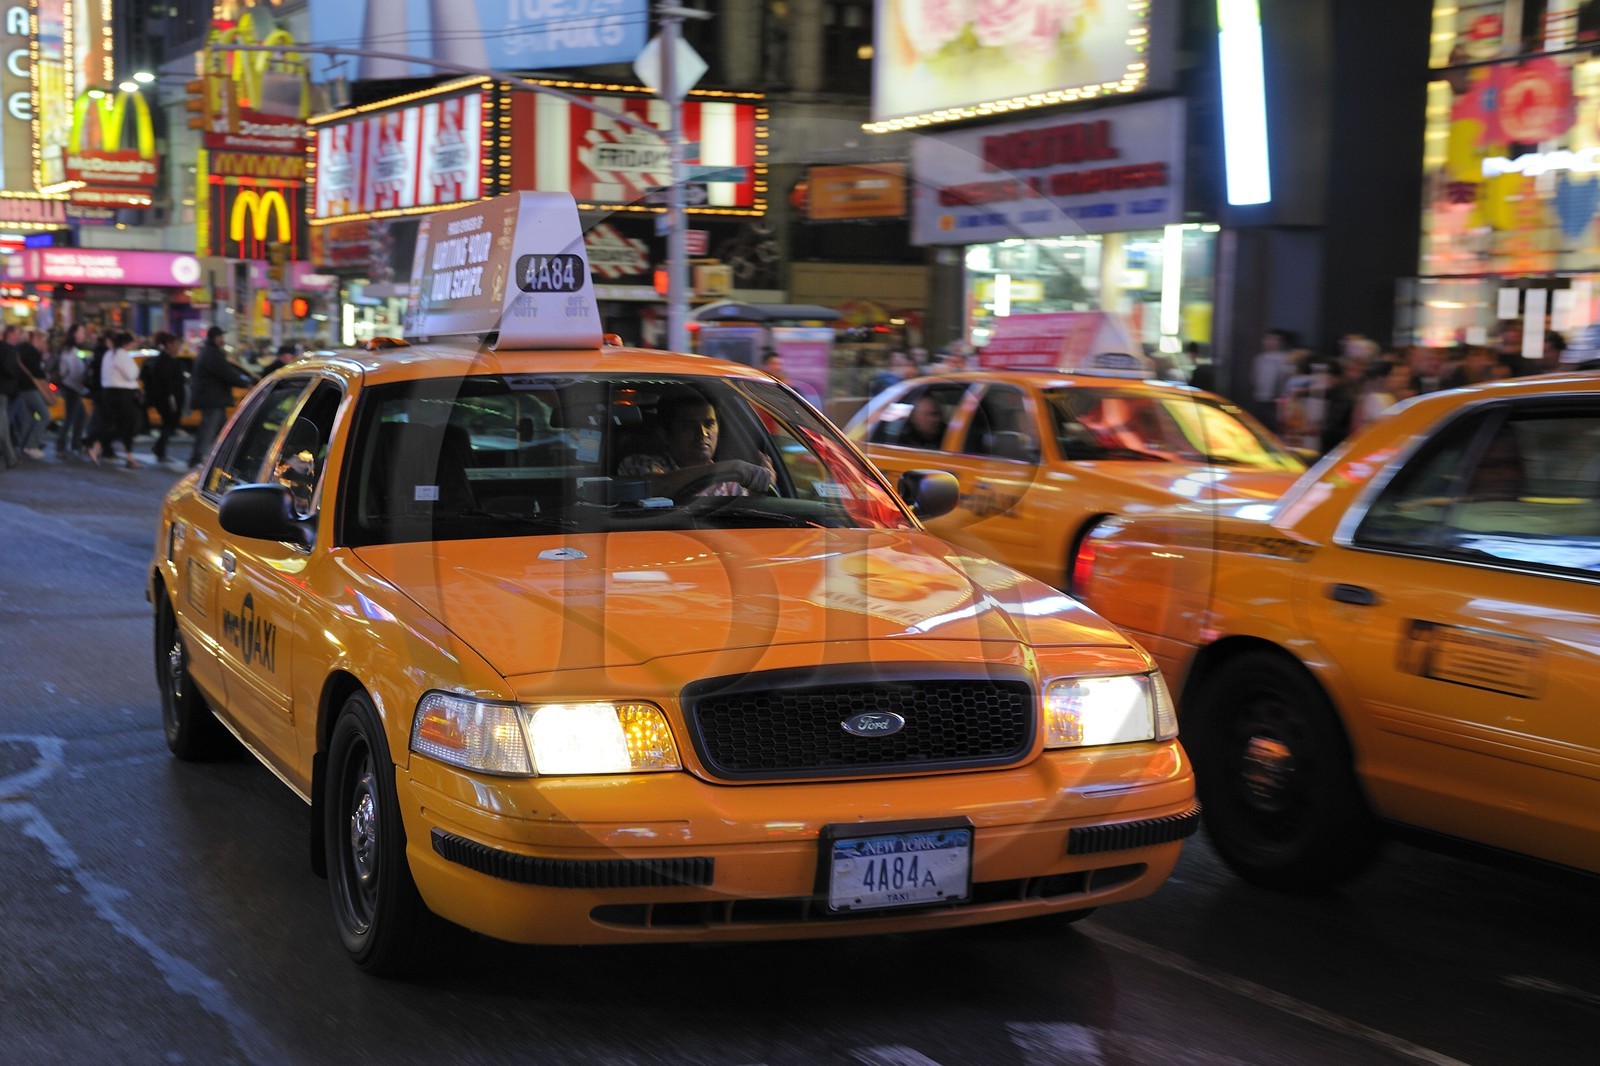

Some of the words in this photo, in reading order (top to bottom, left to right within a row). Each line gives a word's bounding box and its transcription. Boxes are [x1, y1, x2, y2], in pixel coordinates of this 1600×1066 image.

[524, 257, 576, 290] 4A84
[567, 295, 584, 306] OFF
[857, 715, 890, 731] Ford
[866, 840, 896, 856] NEW
[901, 837, 937, 853] YORK
[887, 891, 910, 902] TAXI
